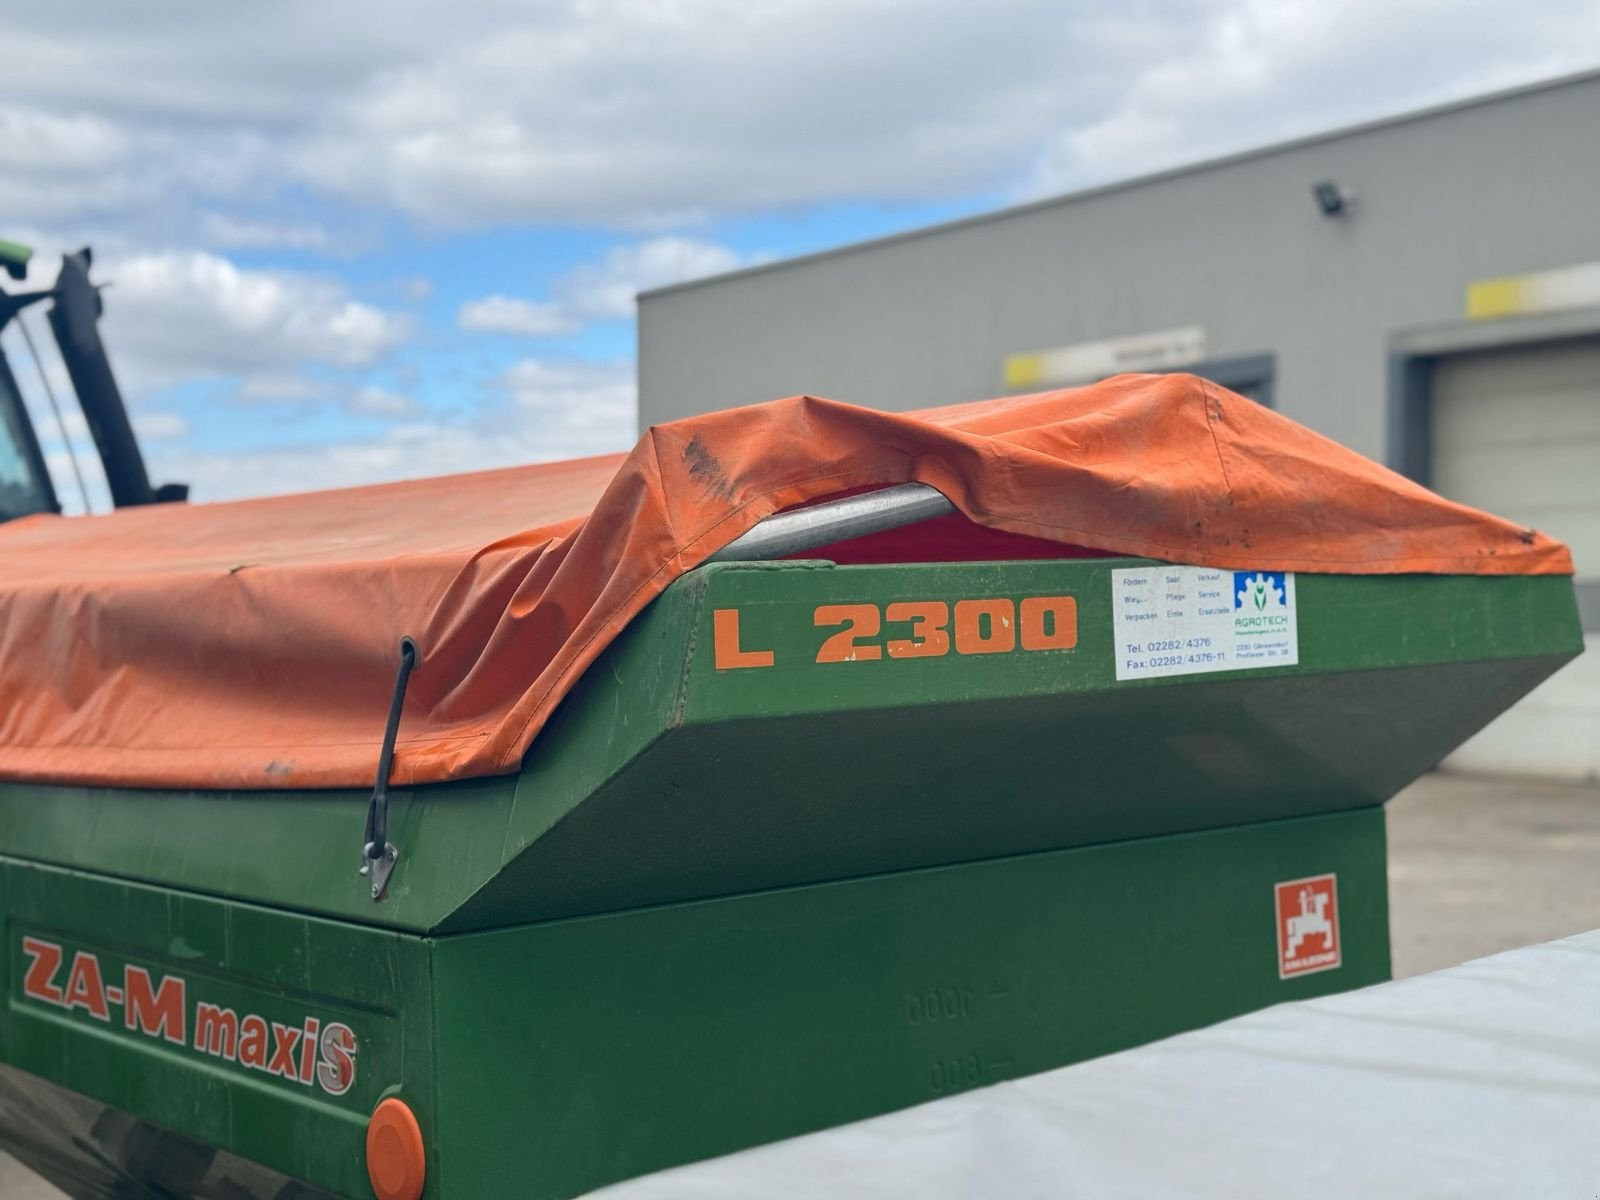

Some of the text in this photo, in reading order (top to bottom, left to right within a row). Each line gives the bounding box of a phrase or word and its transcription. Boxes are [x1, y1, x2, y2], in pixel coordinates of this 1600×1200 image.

[714, 596, 1078, 669] L 2300
[1235, 616, 1288, 627] AGROTECH
[1126, 638, 1212, 654] Tel. 02282/4376
[22, 935, 357, 1095] ZA-M maxiS
